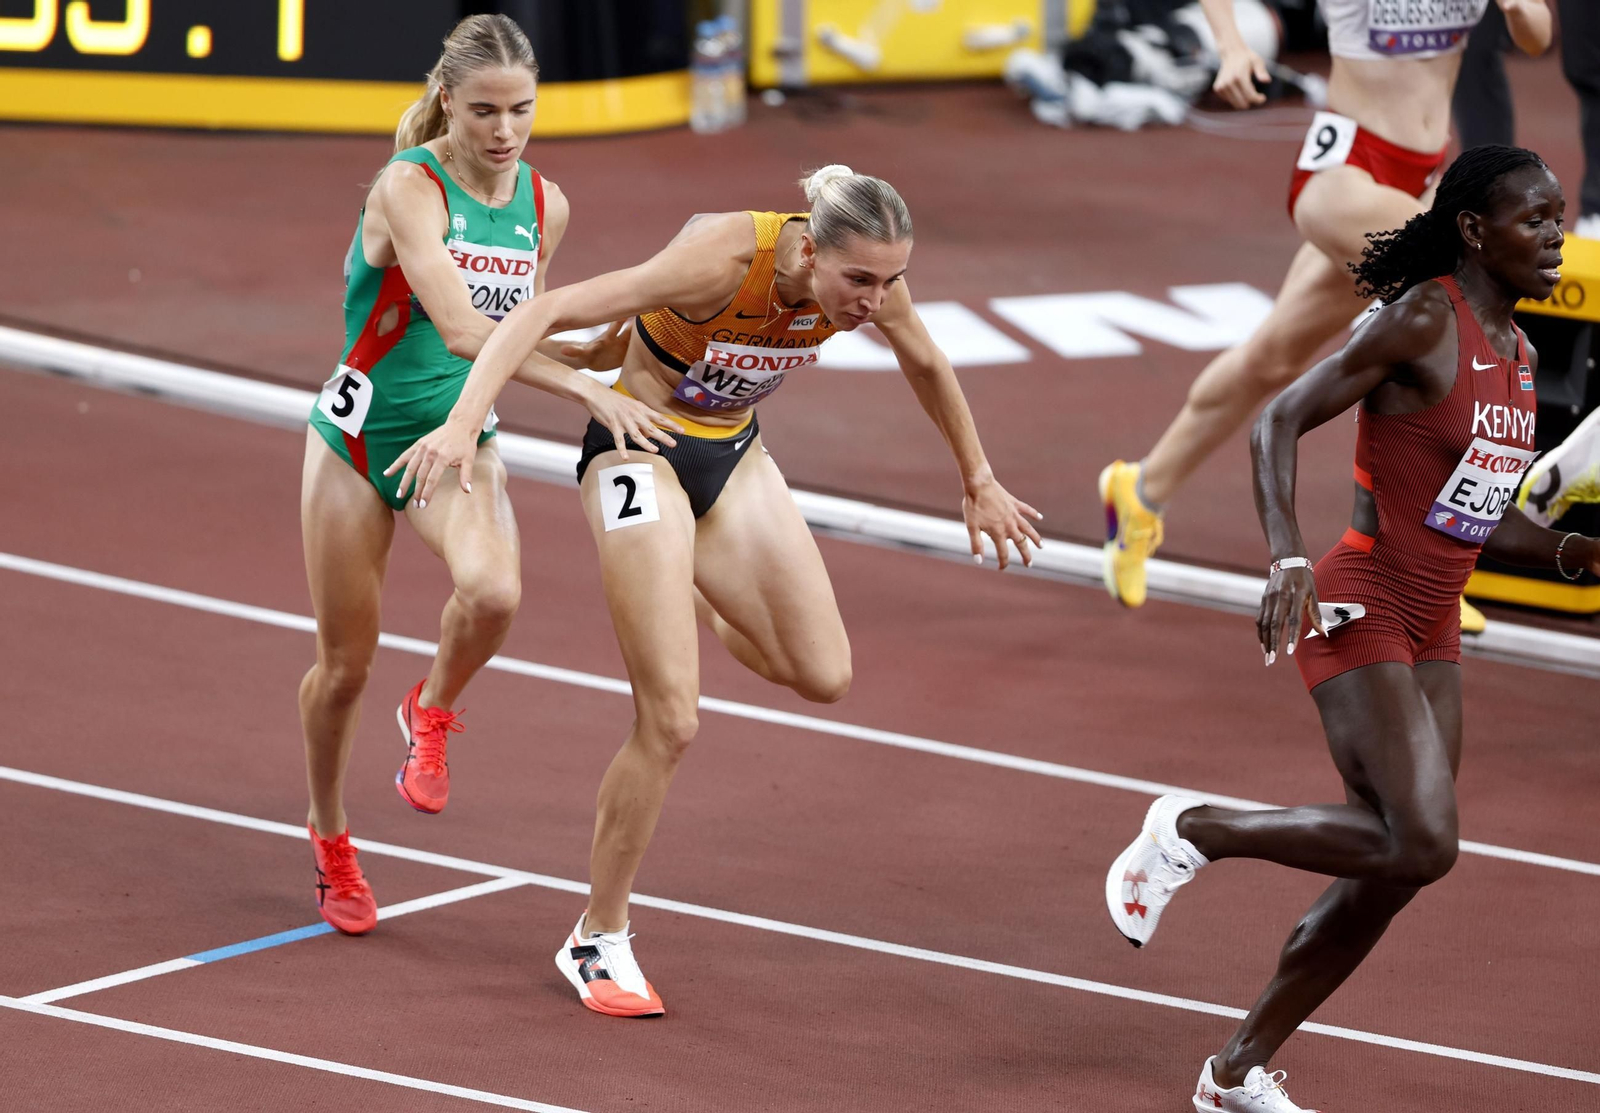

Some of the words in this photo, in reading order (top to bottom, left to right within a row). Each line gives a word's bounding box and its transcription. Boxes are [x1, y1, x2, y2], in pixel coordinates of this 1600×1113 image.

[1312, 125, 1338, 160] 9
[792, 317, 819, 327] WGV
[708, 347, 818, 371] HONDA
[330, 374, 362, 418] 5
[1471, 400, 1536, 445] KENYA
[612, 474, 642, 520] 2
[1448, 477, 1516, 517] EJOR
[1460, 521, 1498, 538] TOKY
